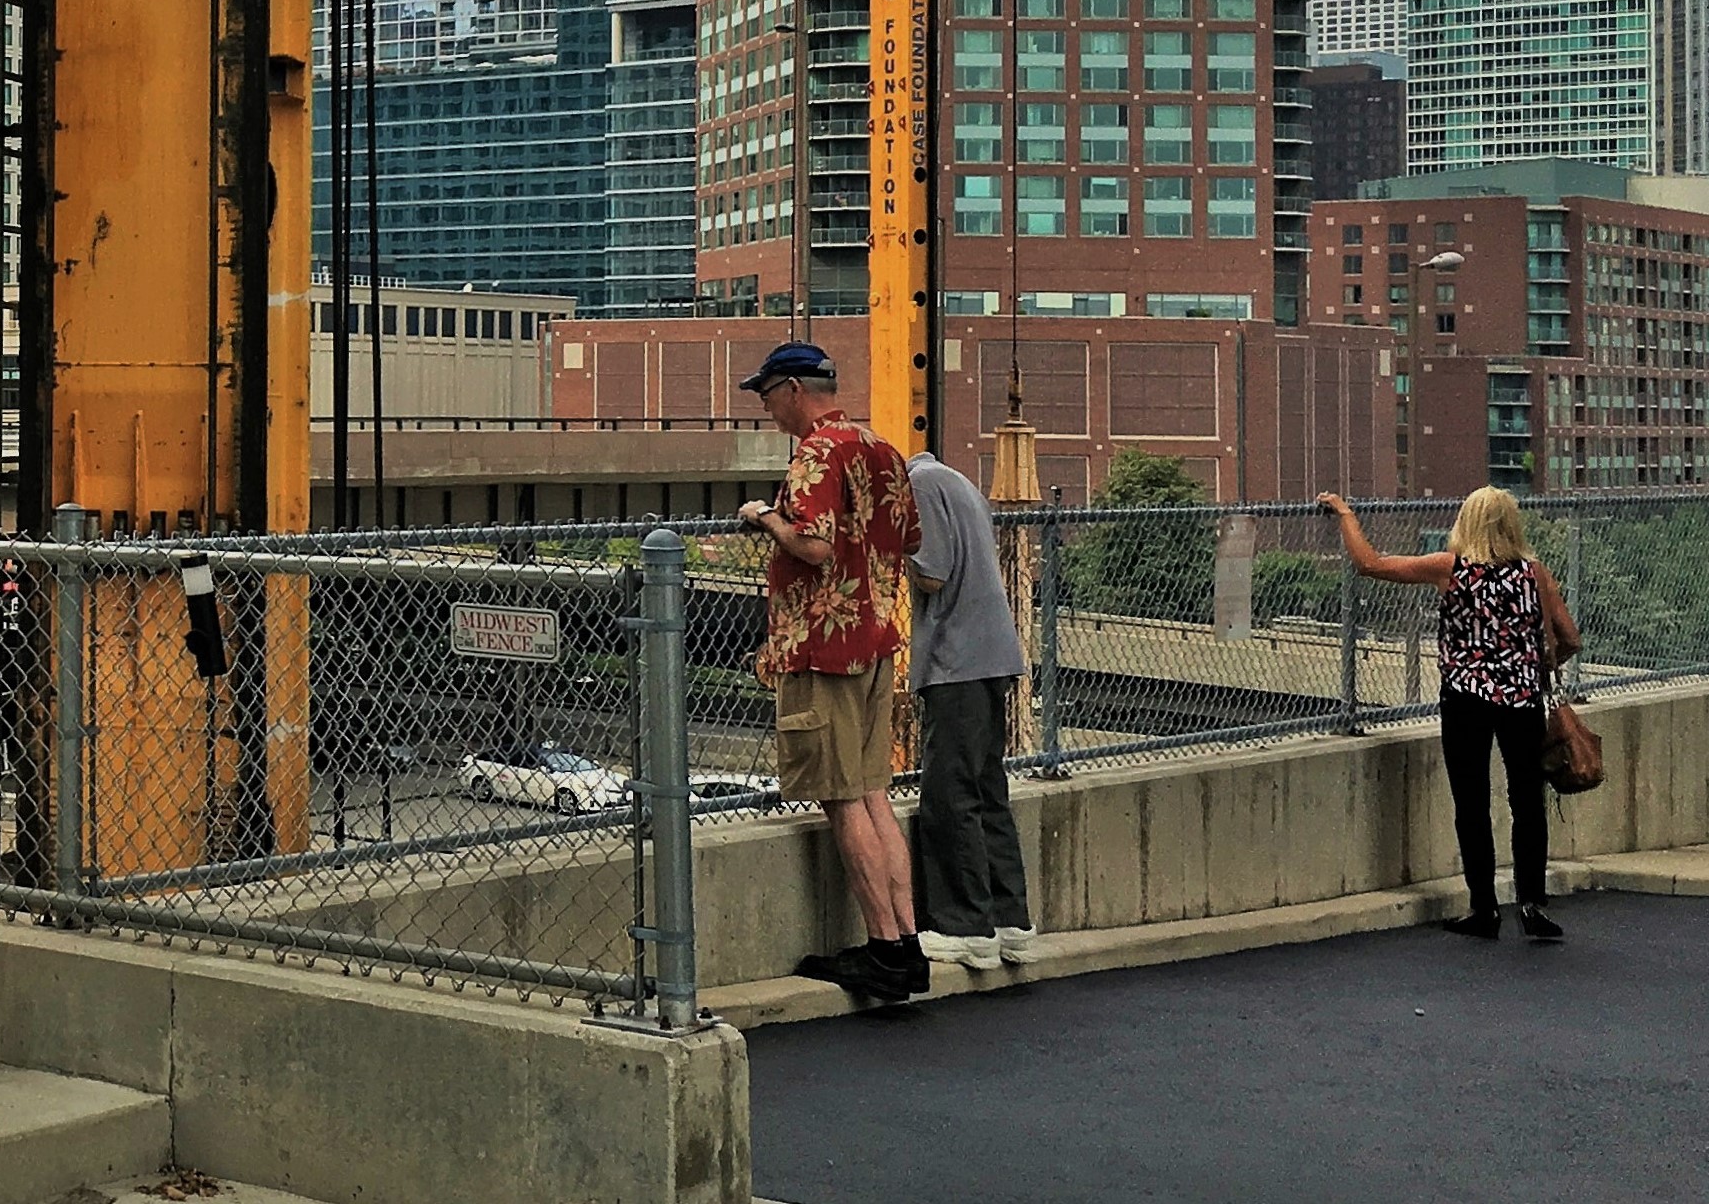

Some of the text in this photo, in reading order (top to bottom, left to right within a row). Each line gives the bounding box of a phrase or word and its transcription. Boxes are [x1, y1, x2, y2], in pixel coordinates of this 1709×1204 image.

[884, 18, 896, 215] FOUNDATION
[912, 109, 925, 166] CASE
[459, 610, 550, 635] MIDWEST
[475, 630, 534, 653] FENCE
